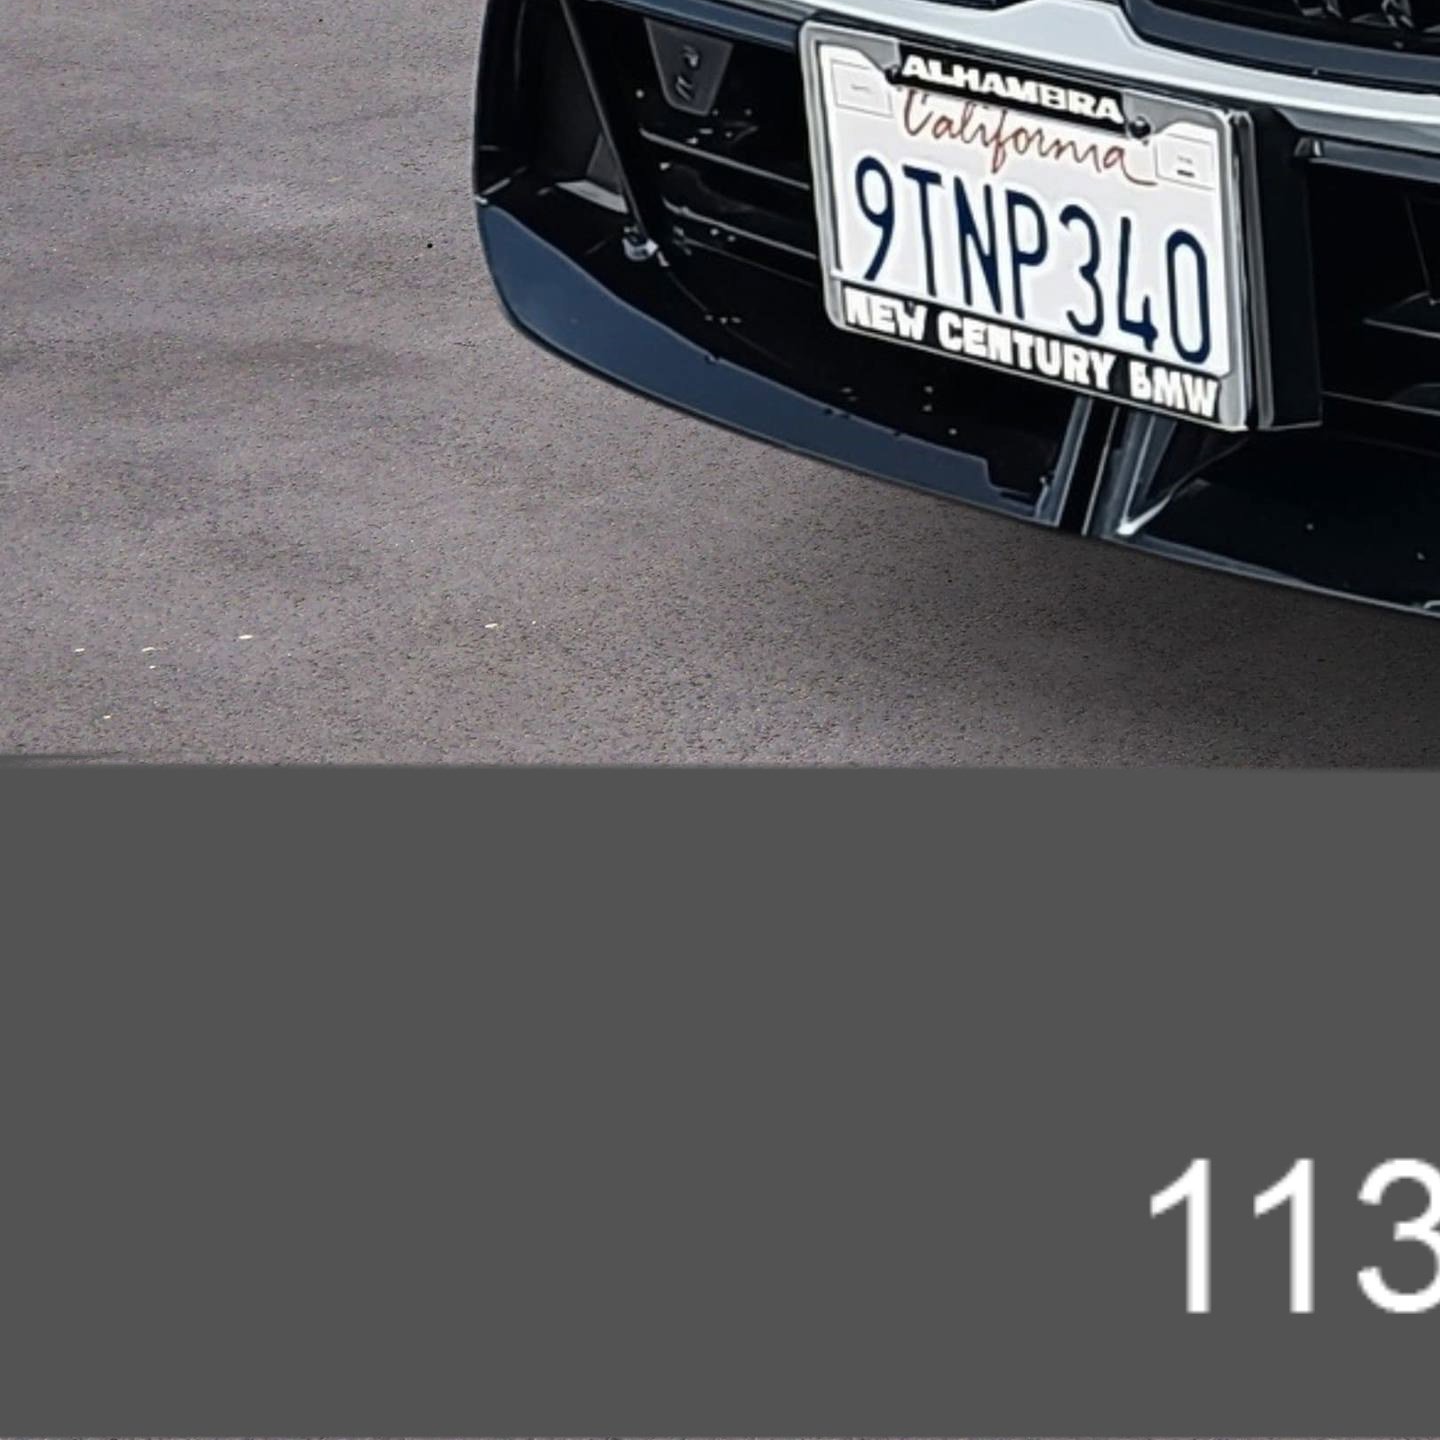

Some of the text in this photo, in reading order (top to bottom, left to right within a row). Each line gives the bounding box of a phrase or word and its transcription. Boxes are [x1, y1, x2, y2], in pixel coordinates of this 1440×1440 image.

[901, 54, 1125, 123] ALHAMBRA
[903, 88, 1157, 187] California
[854, 155, 1211, 364] 9TNP340
[842, 286, 1219, 419] NEW CENTURY BMW
